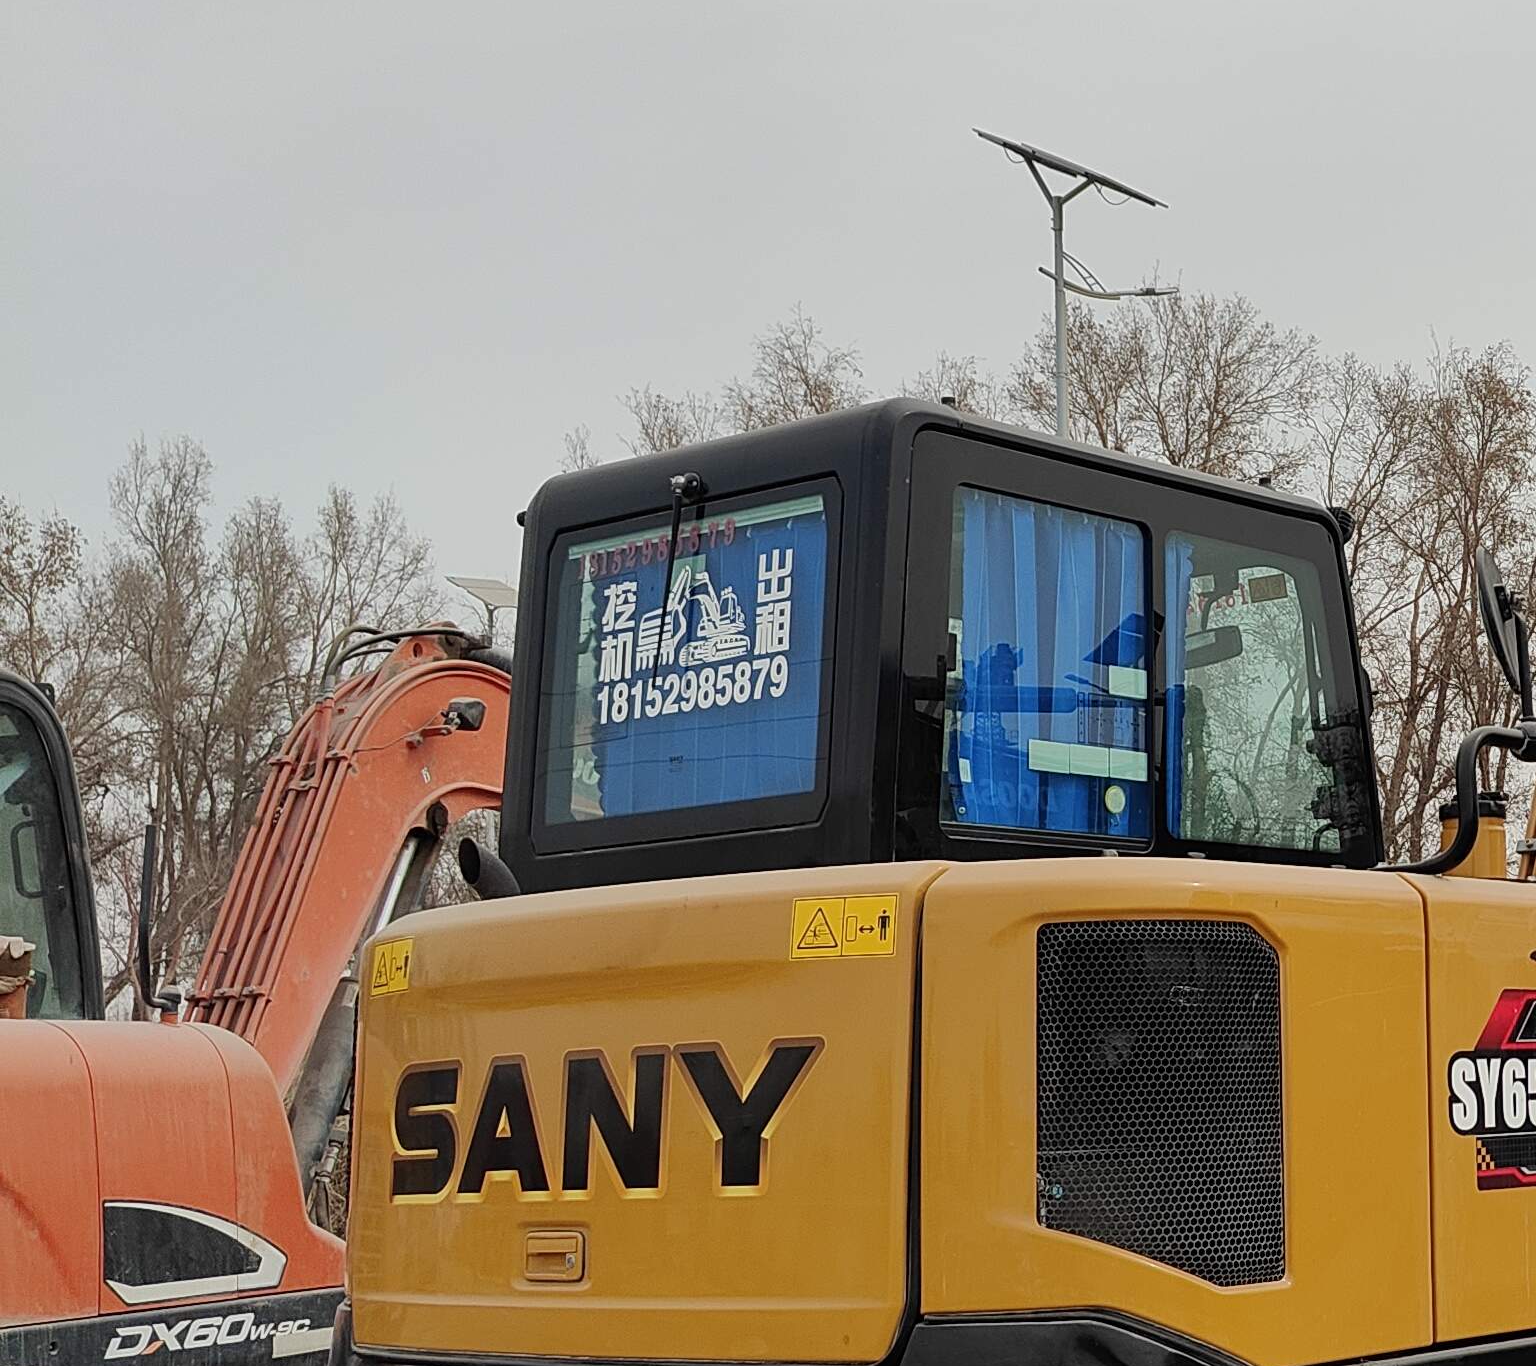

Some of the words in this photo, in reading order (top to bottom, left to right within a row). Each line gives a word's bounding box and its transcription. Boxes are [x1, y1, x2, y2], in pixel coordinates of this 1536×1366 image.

[598, 580, 638, 684] 挖机
[753, 547, 794, 655] 出租
[596, 654, 789, 725] 18152985879
[390, 1042, 820, 1199] SANY
